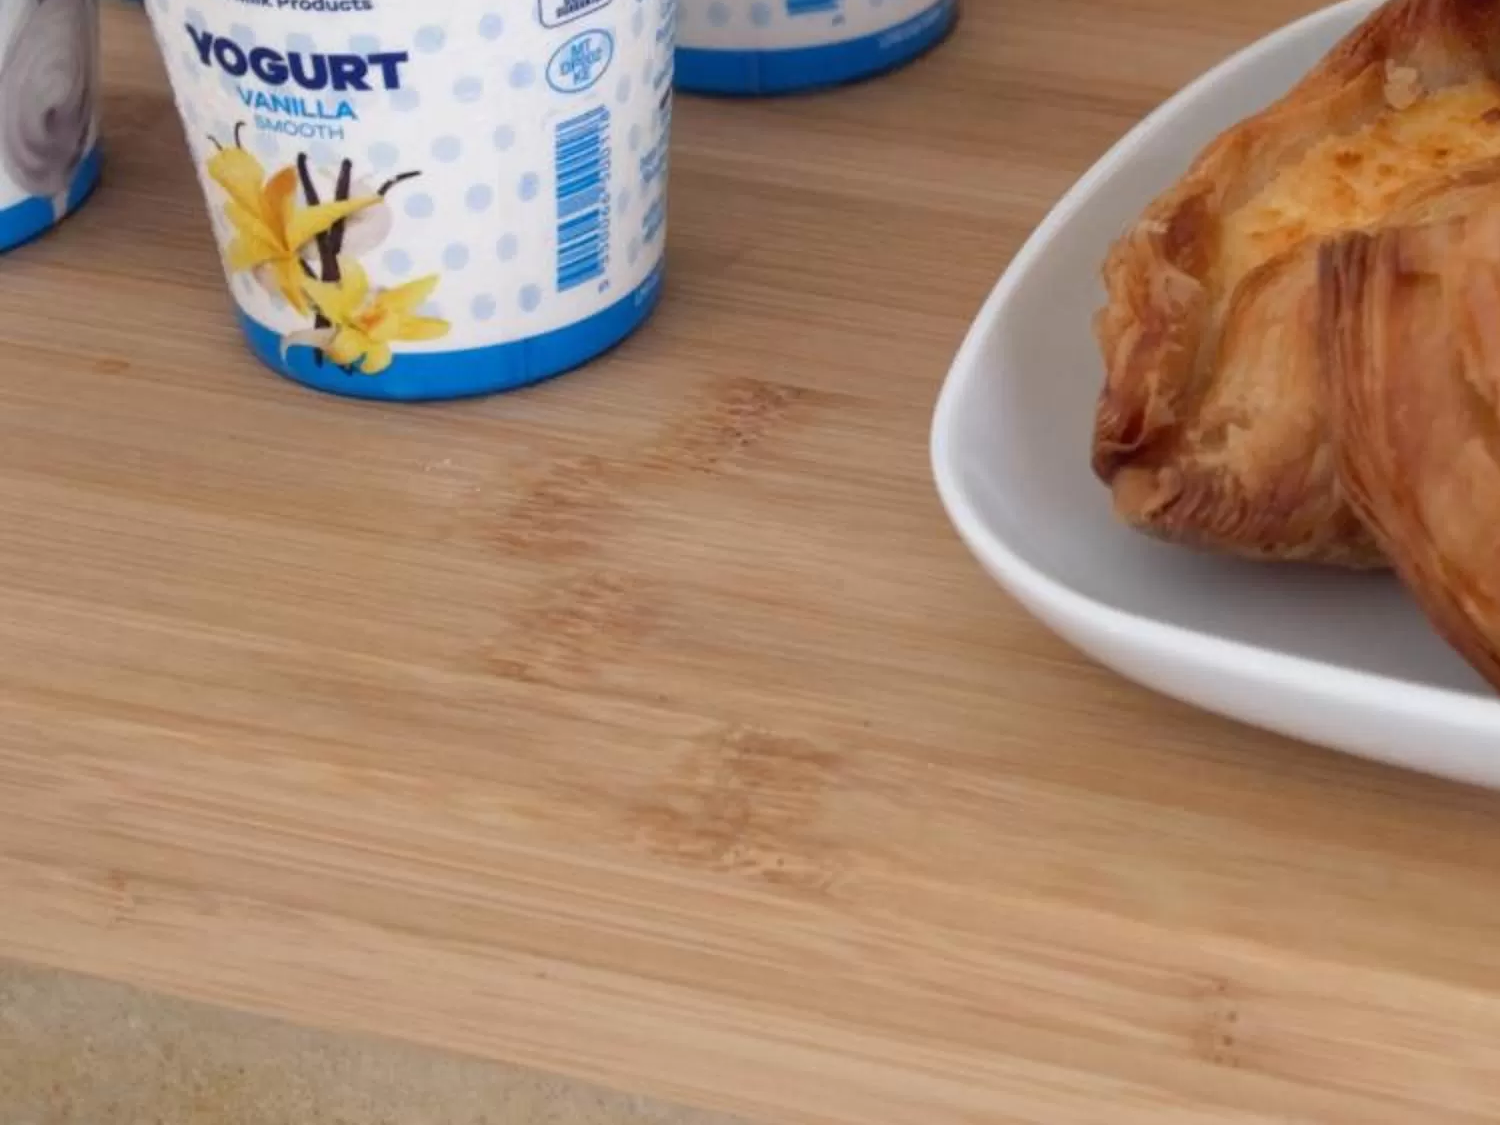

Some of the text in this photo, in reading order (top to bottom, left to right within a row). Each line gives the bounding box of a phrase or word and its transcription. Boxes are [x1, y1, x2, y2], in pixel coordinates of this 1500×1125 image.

[185, 23, 408, 92] YOGURT
[236, 86, 358, 121] VANILLA
[253, 114, 345, 140] SMOOTH
